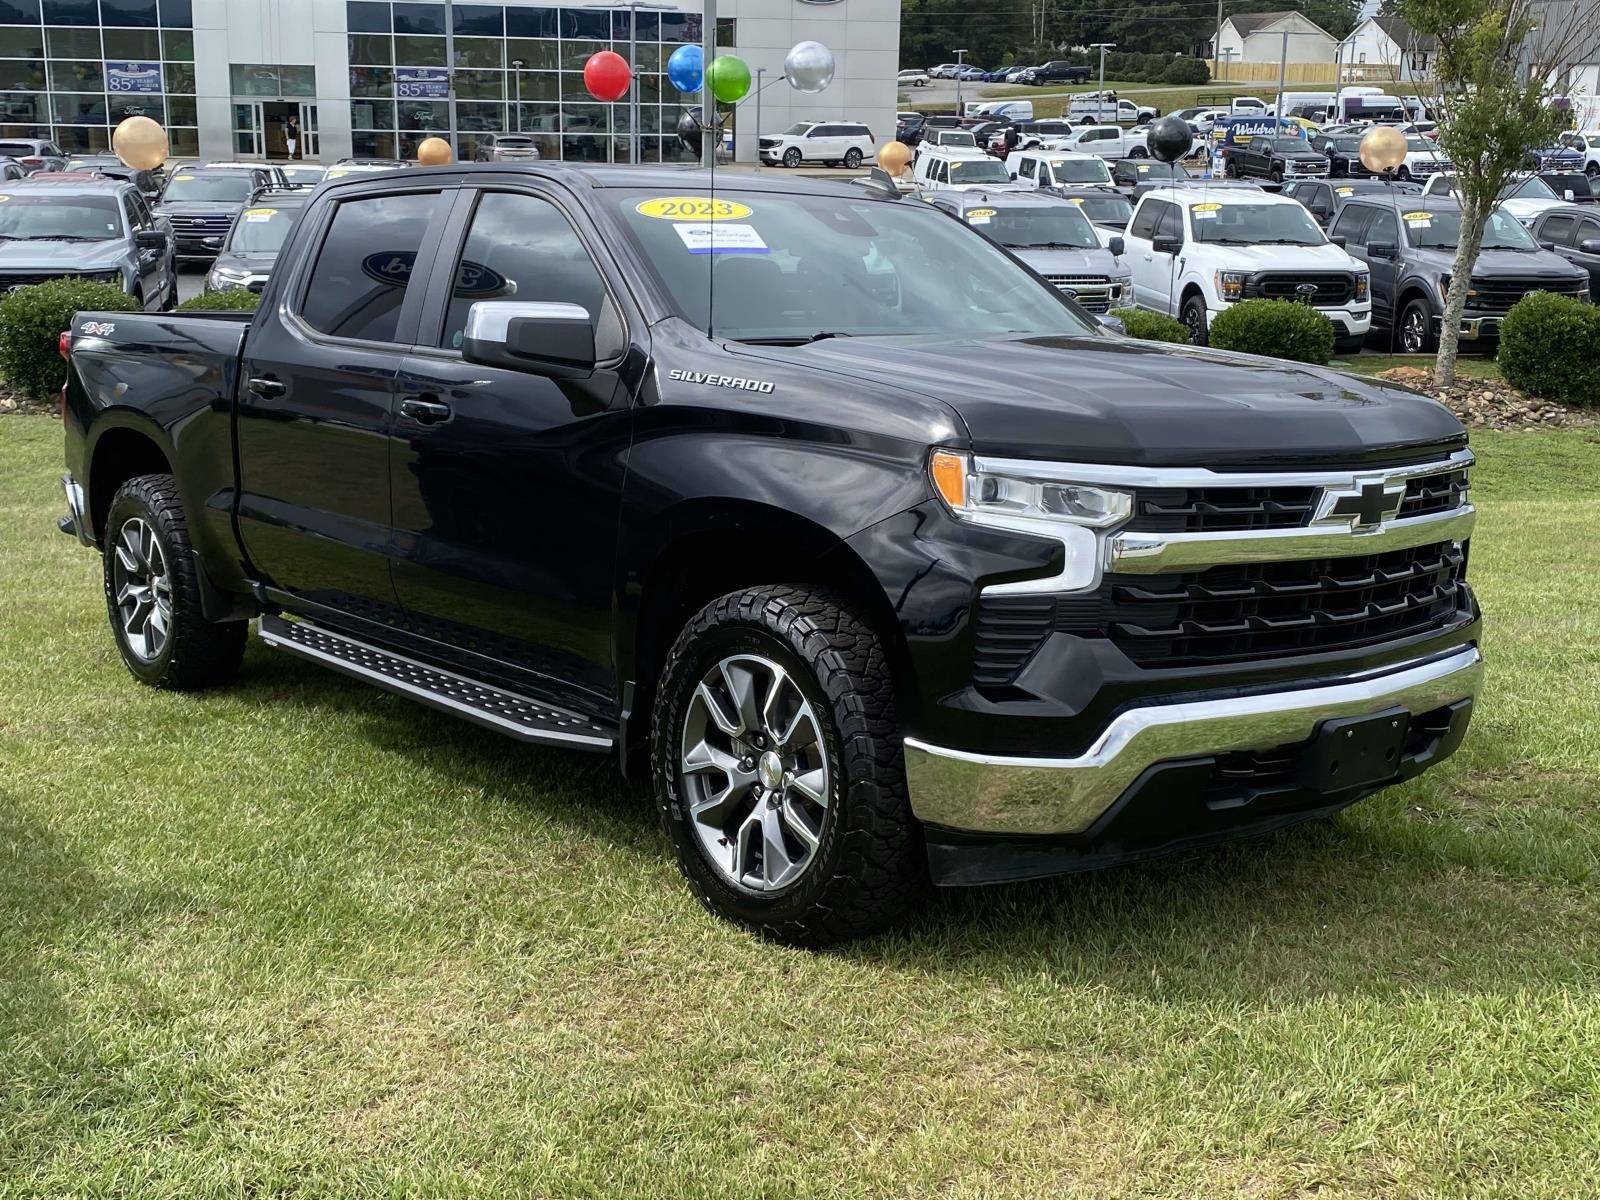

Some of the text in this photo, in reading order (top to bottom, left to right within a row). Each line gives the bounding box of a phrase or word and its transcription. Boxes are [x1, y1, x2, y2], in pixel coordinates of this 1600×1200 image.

[110, 77, 136, 91] 85+
[399, 83, 425, 97] 85+
[660, 202, 734, 216] 2023
[668, 369, 776, 394] SILVERADO
